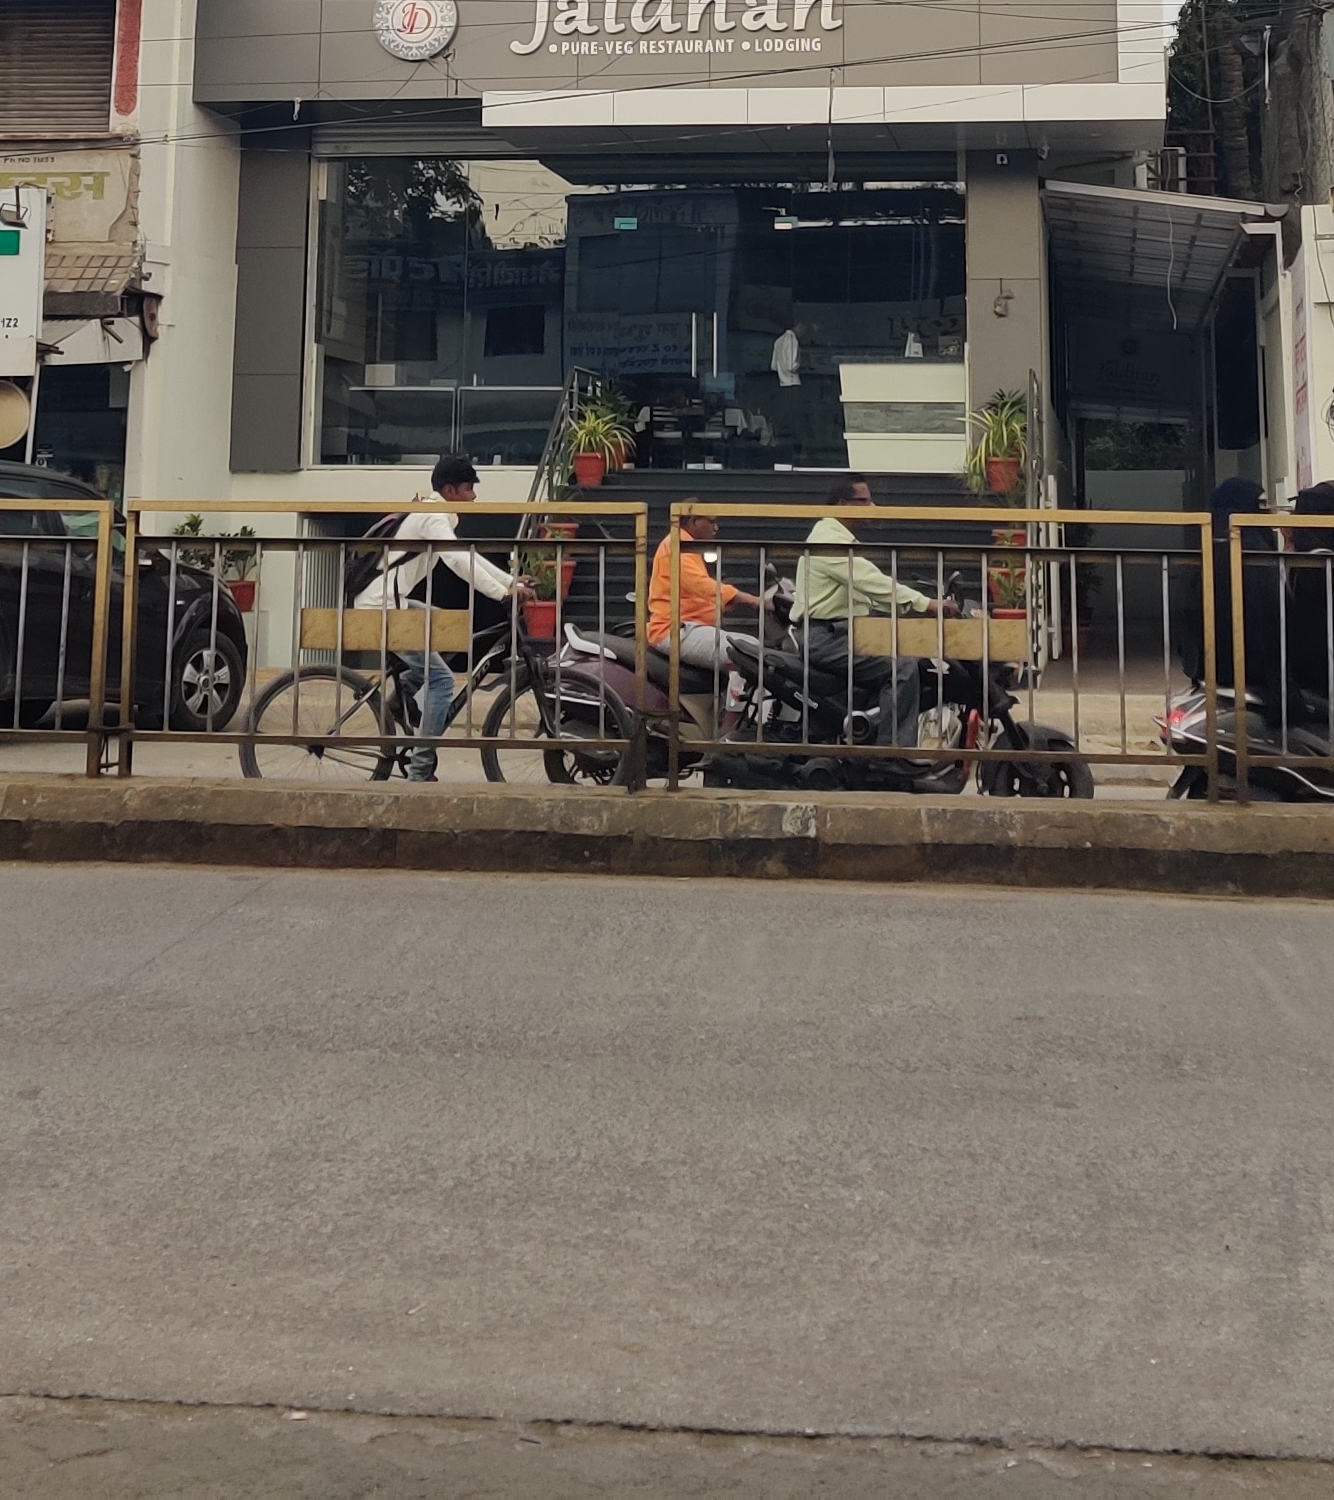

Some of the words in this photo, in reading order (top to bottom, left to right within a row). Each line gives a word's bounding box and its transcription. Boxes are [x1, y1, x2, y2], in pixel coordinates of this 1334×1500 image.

[561, 40, 634, 55] PURE-VEG
[639, 38, 735, 55] RESTAURANT
[754, 37, 822, 53] LODGING
